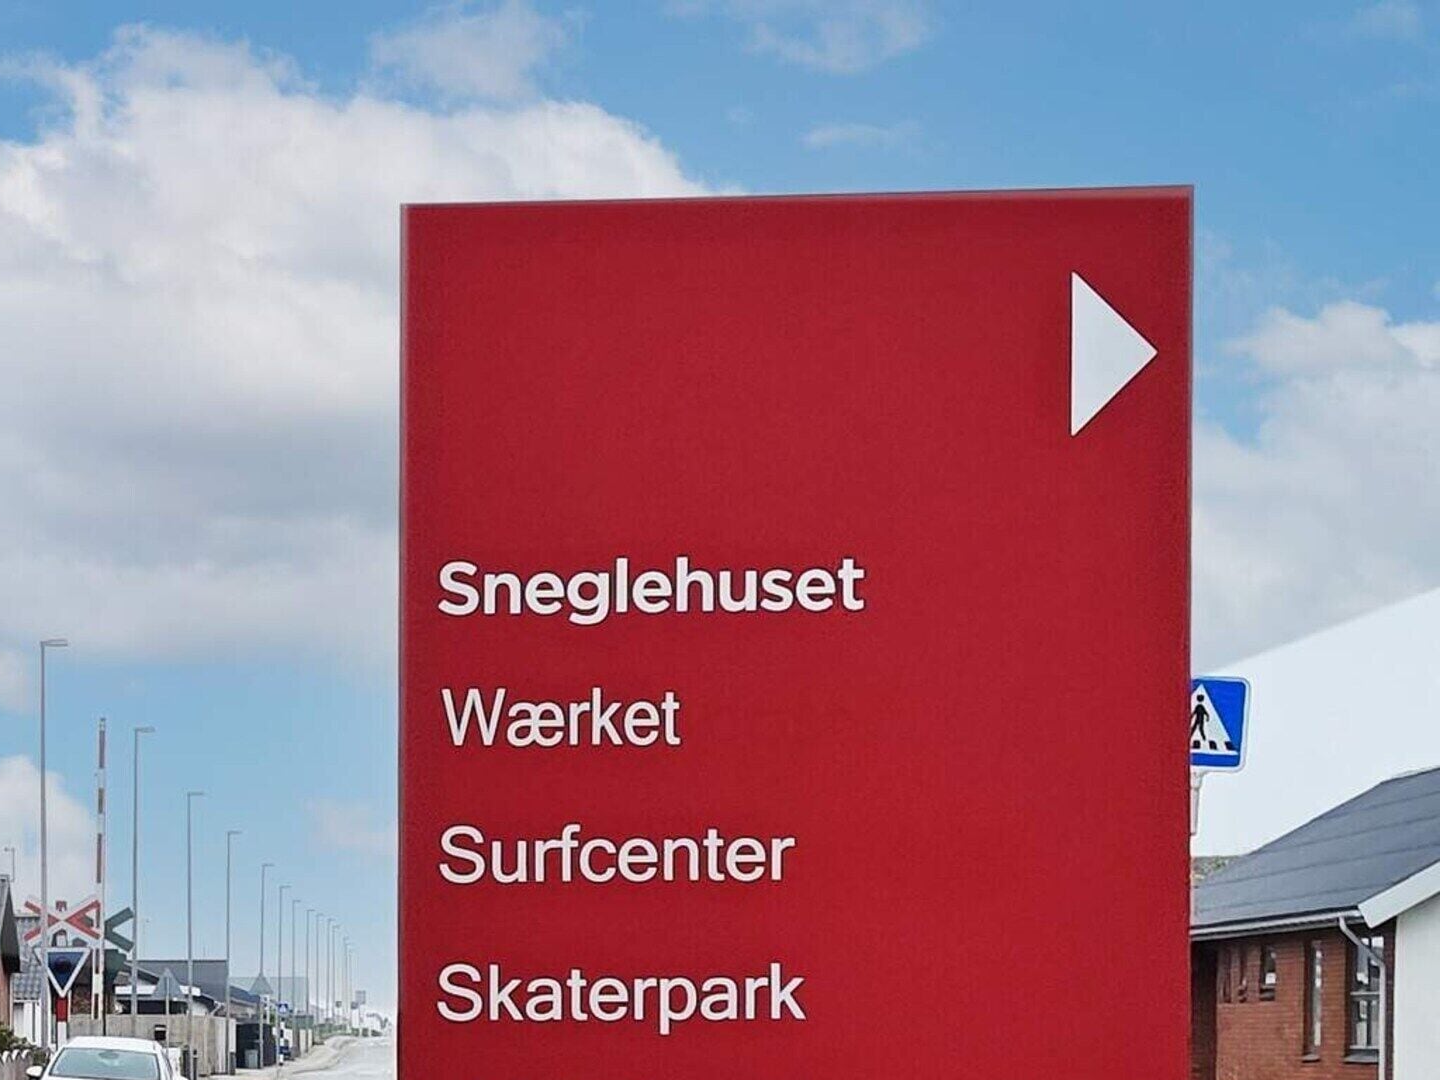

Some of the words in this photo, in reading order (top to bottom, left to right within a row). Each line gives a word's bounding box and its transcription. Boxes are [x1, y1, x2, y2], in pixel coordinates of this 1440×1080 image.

[437, 556, 866, 625] Sneglehuset
[440, 687, 682, 748] Wærket
[438, 822, 797, 885] Surfcenter
[436, 962, 807, 1036] Skaterpark
